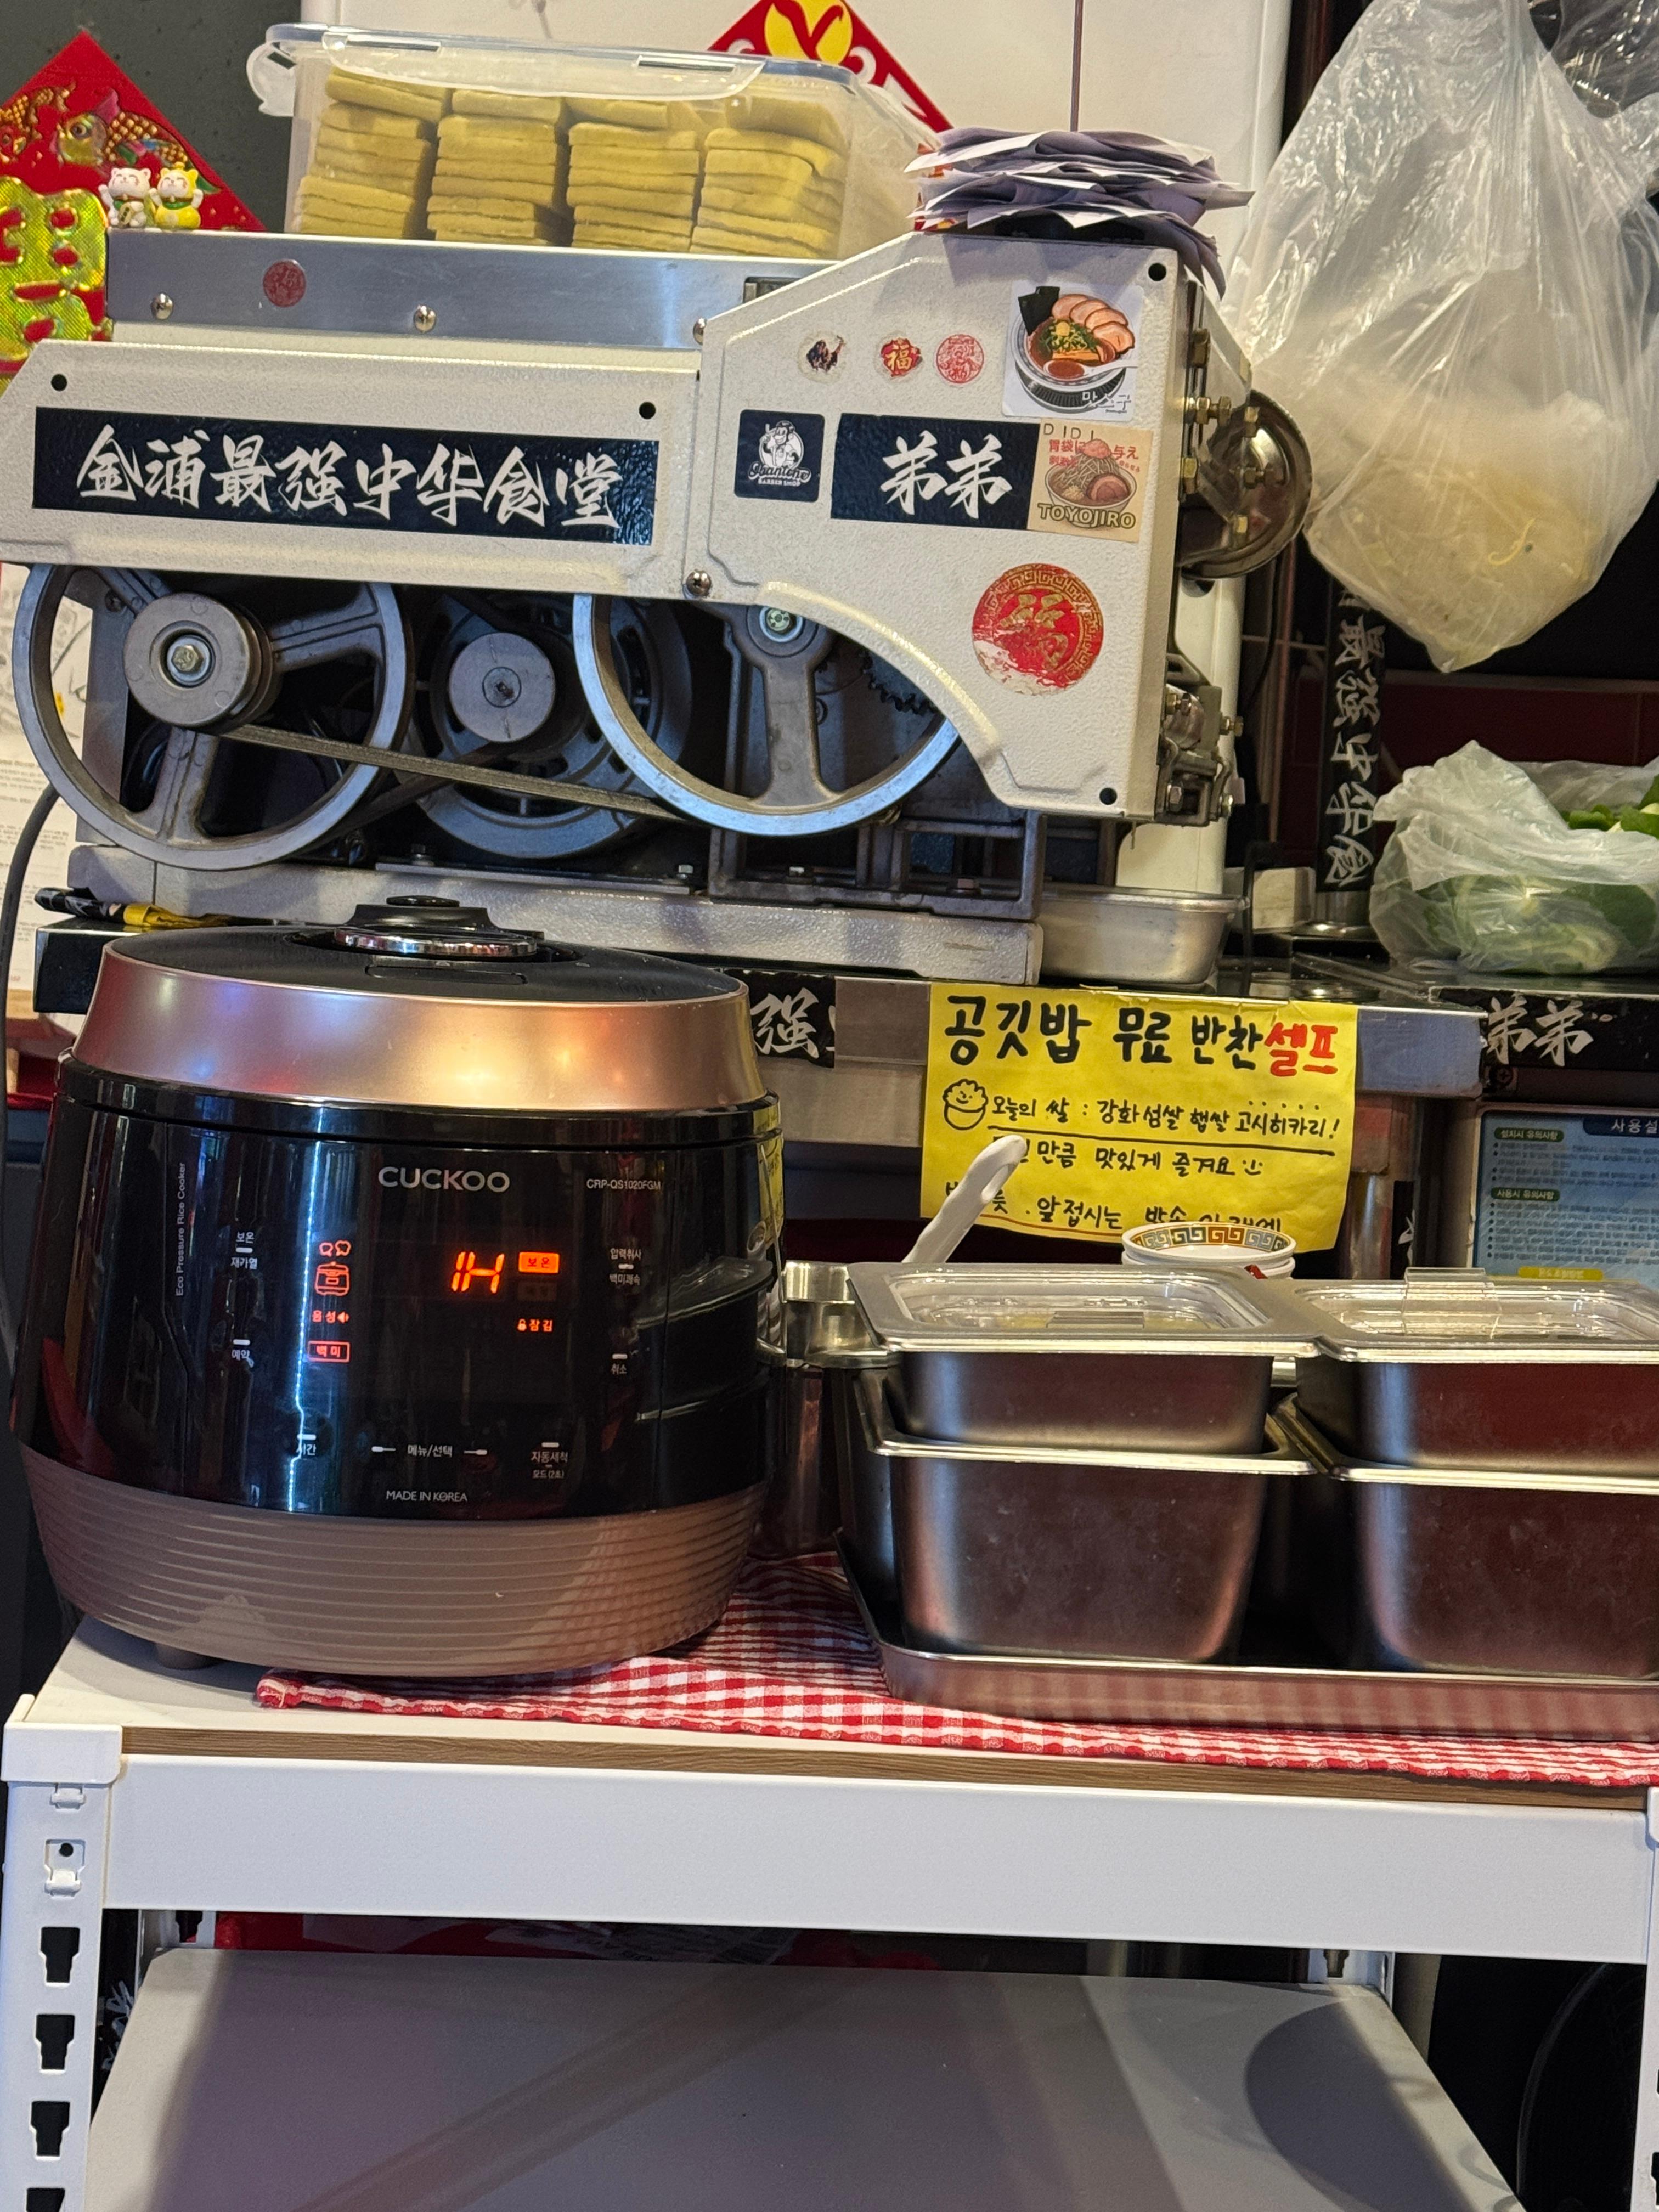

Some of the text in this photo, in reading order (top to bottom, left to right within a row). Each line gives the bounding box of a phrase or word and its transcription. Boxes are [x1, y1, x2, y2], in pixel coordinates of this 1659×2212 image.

[880, 430, 1013, 519] 弟弟
[1037, 503, 1136, 529] TOYOJIRO
[944, 995, 1093, 1066] 공깃밥
[1112, 1007, 1173, 1064] 무료
[1486, 991, 1594, 1067] 弟弟
[992, 1096, 1037, 1122] 오늘의
[1046, 1097, 1070, 1122] 쌀
[1096, 1147, 1161, 1172] 맛있게
[1172, 1152, 1236, 1177] 즐겨요
[378, 1166, 510, 1193] CUCKOO
[176, 1163, 187, 1296] Eco Pressure Rice Cooker
[236, 1232, 255, 1244] 보온
[231, 1257, 258, 1270] 재가열
[529, 1319, 554, 1333] 잠김
[316, 1345, 341, 1358] 백미
[610, 1363, 628, 1375] 취소
[408, 1444, 453, 1458] 메뉴/선택
[531, 1451, 568, 1464] 자동세척
[386, 1490, 468, 1502] MADE IN KOREA
